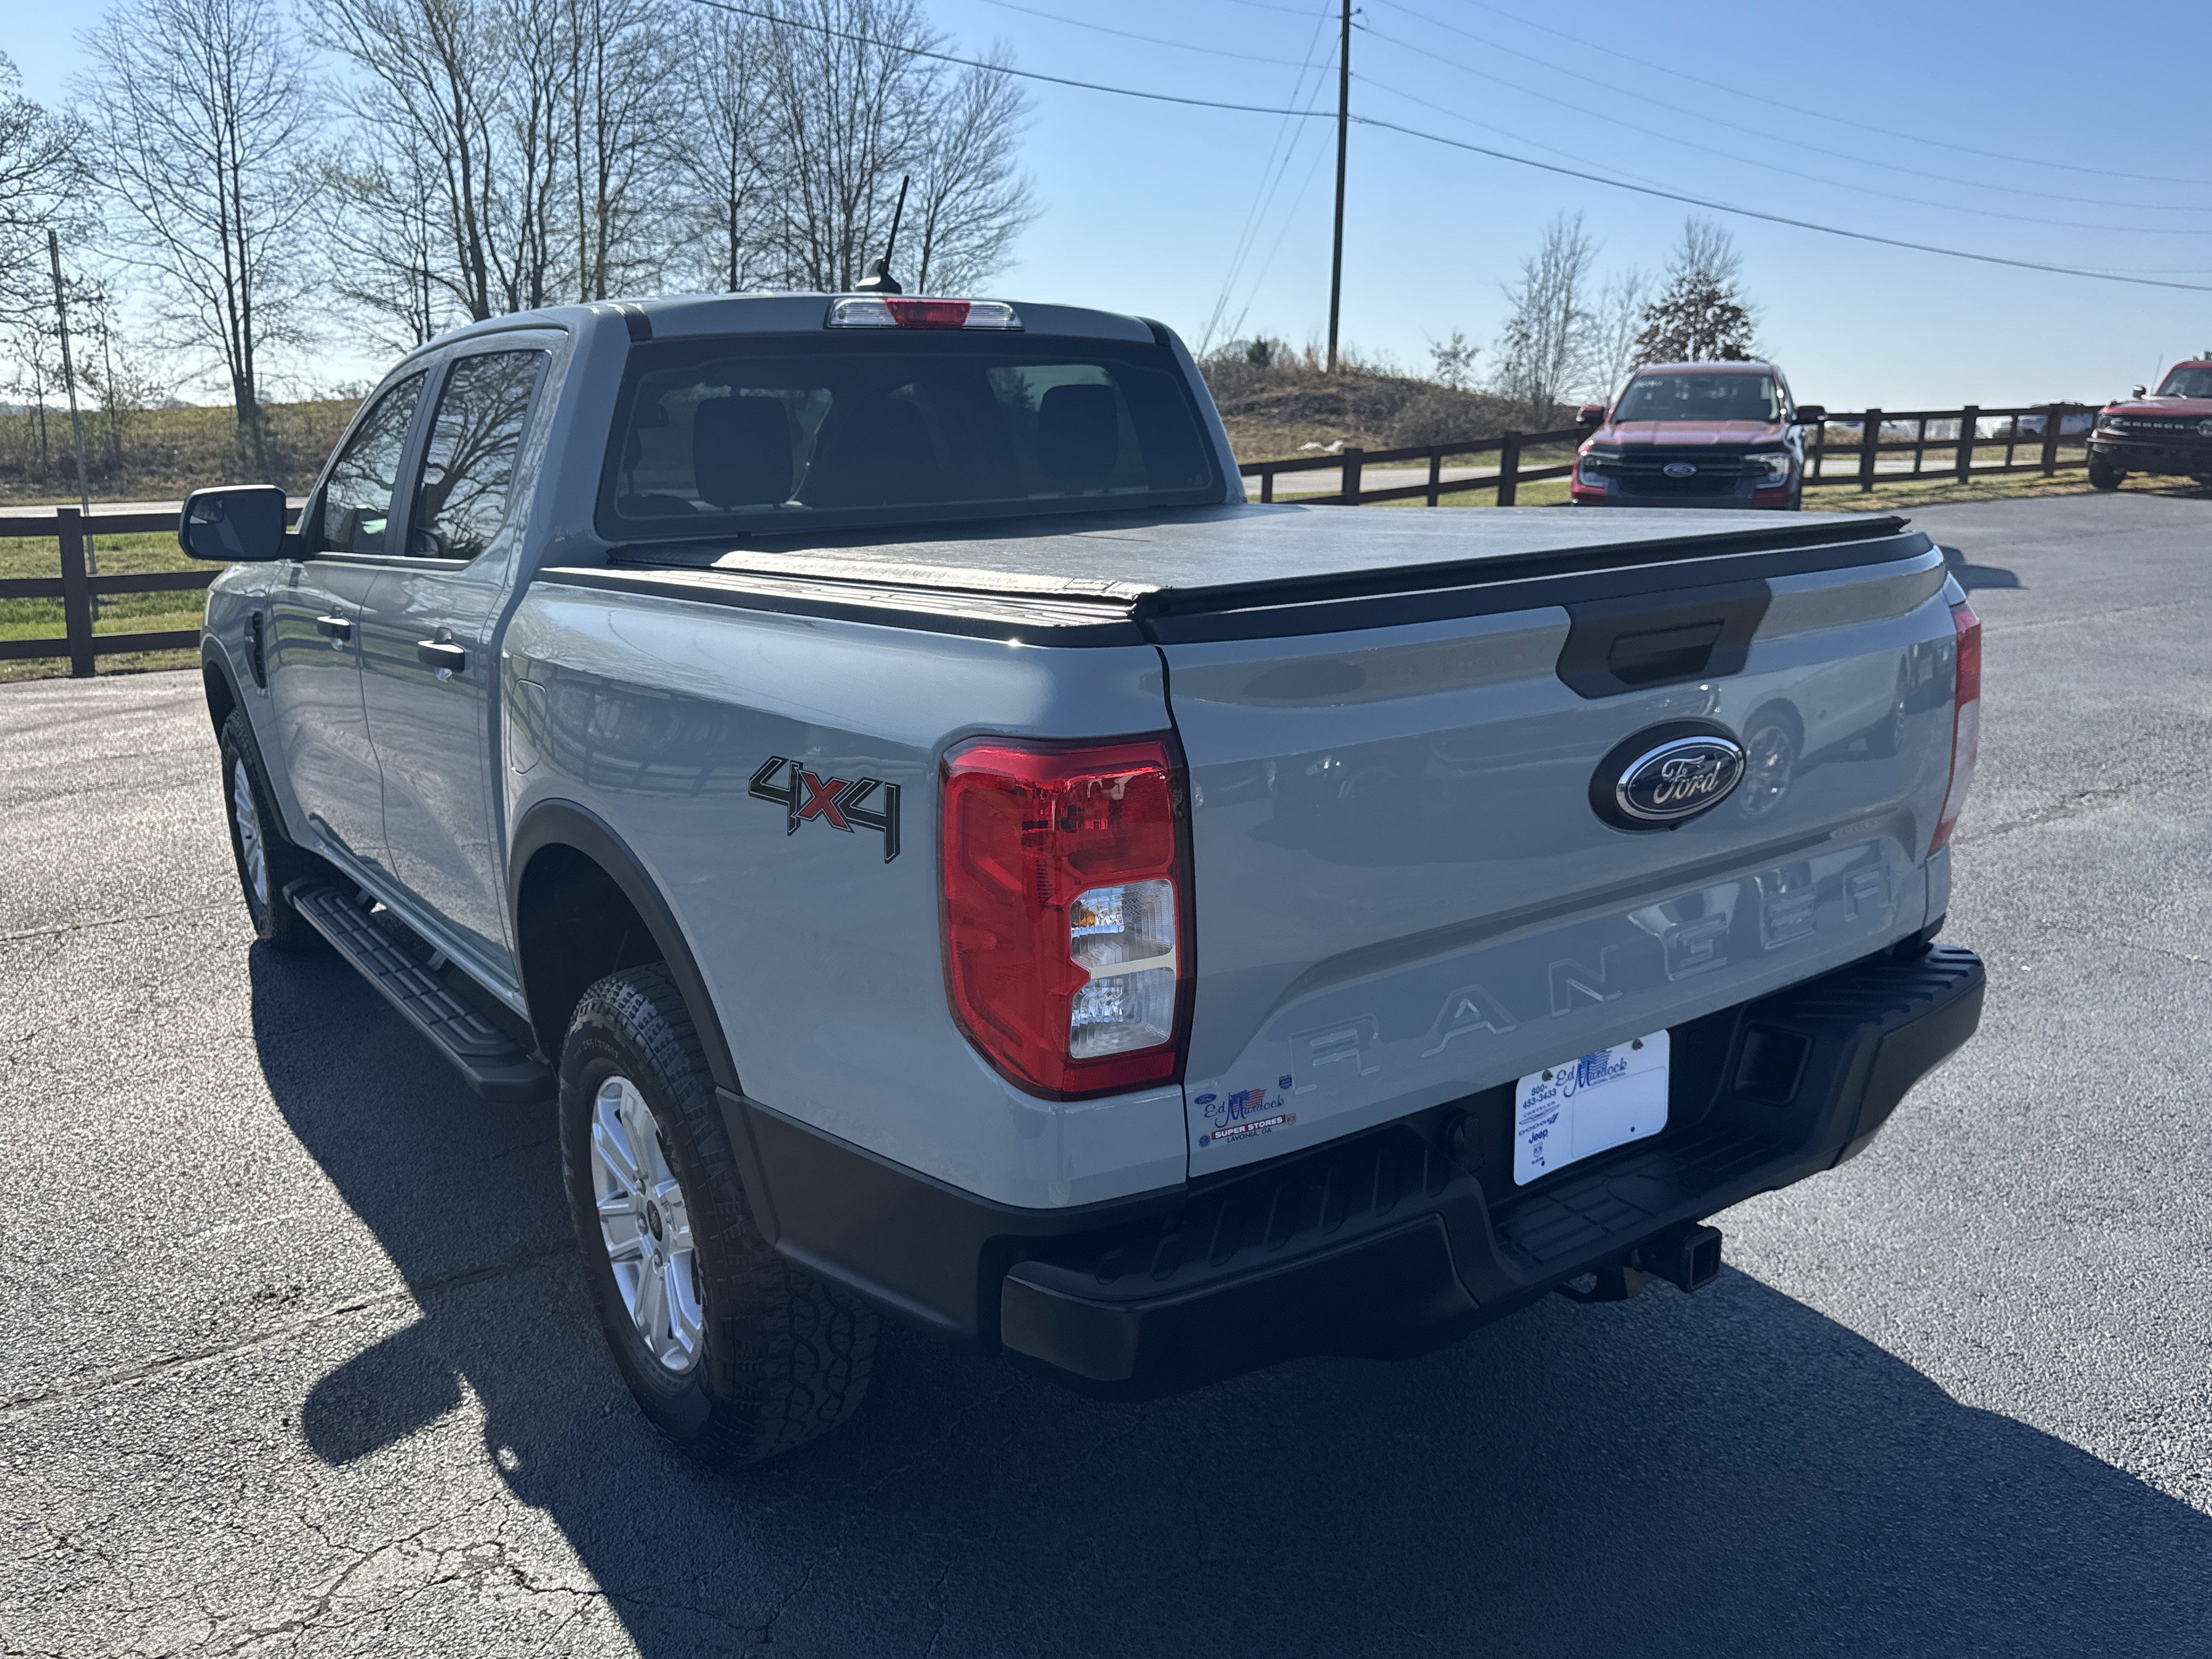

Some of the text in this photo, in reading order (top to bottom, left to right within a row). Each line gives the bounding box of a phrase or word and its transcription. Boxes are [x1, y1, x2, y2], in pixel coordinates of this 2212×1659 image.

[1653, 755, 1721, 804] Ford
[1288, 840, 1893, 1096] RANGER
[1555, 1065, 1575, 1087] Ed
[1564, 1058, 1628, 1098] Murdock
[1204, 1092, 1284, 1128] Ed Murdock
[1215, 1116, 1283, 1139] SUPER STORES
[1528, 1129, 1548, 1144] Jeep
